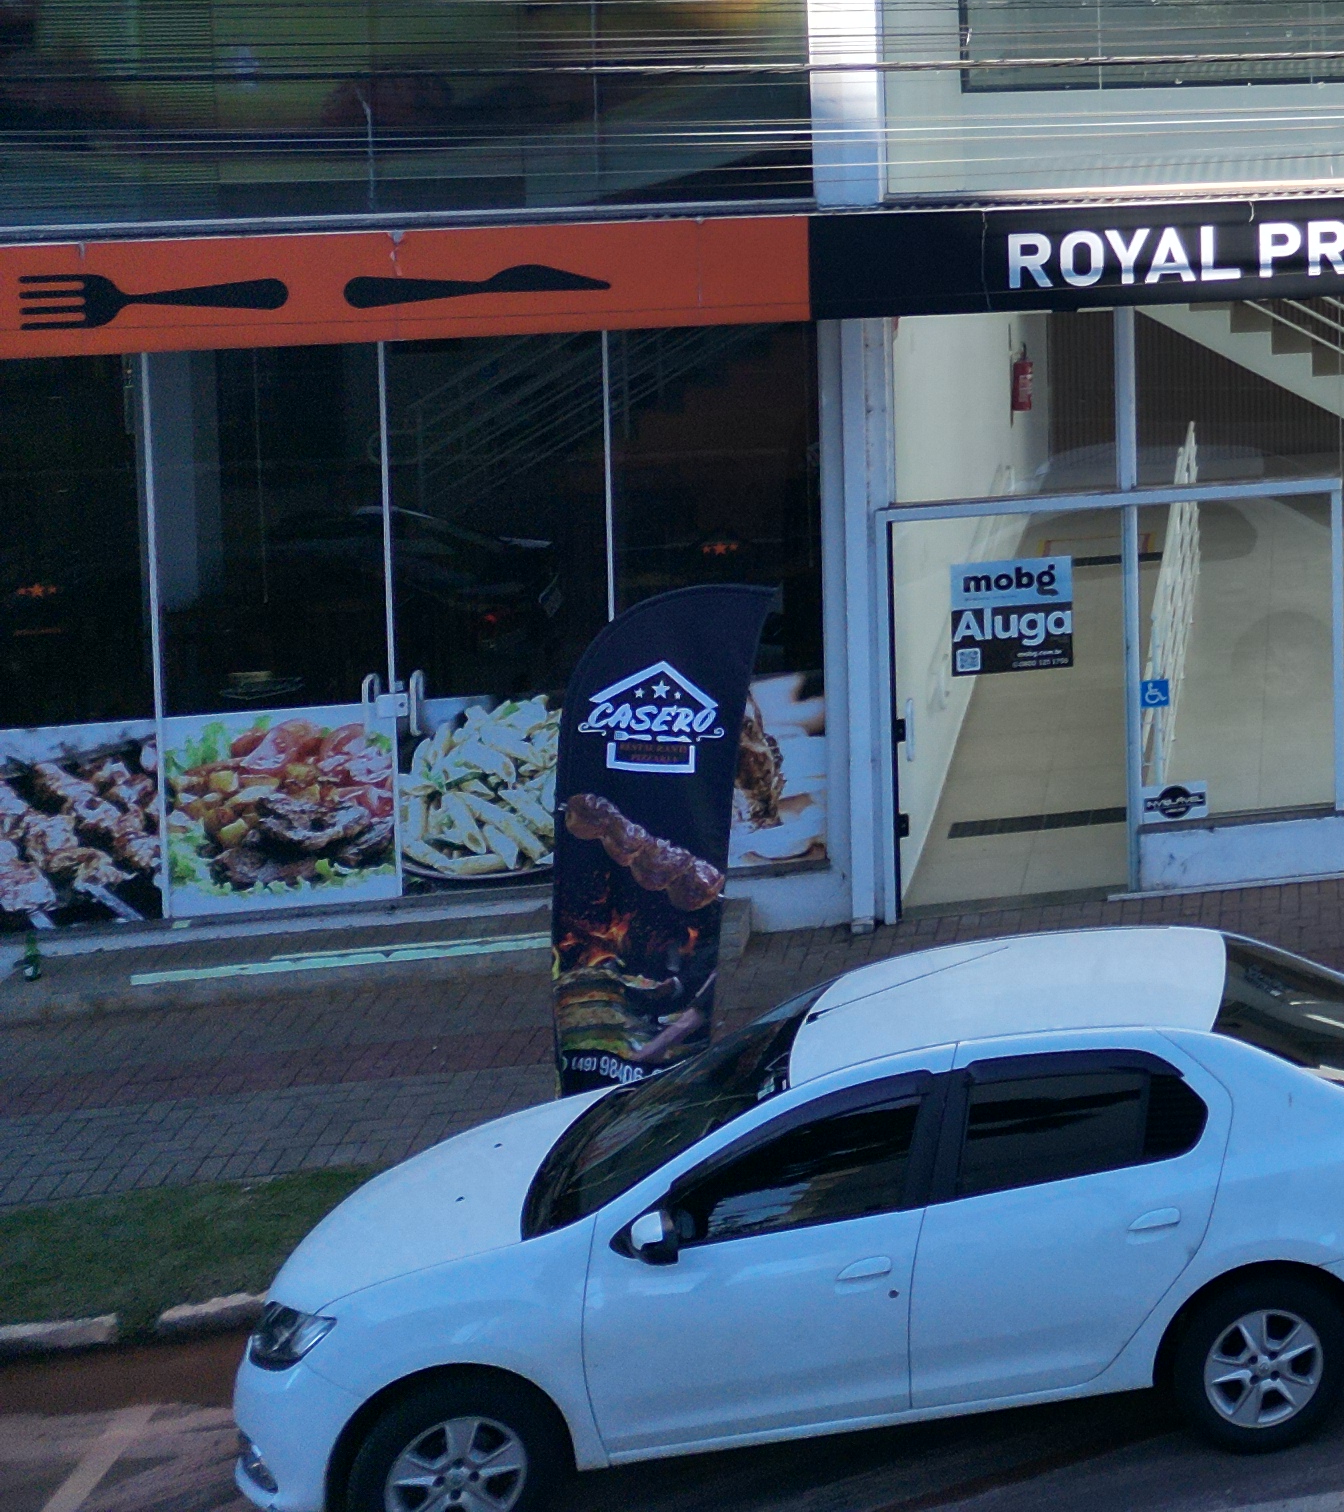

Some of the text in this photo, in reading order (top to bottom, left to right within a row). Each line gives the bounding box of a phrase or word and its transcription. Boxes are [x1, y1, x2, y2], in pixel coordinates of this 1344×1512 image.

[1007, 224, 1241, 289] ROYAL
[962, 563, 1060, 597] mobg
[953, 607, 1073, 647] Aluga
[587, 702, 717, 733] CASERO
[571, 1055, 661, 1084] (49) 98406
